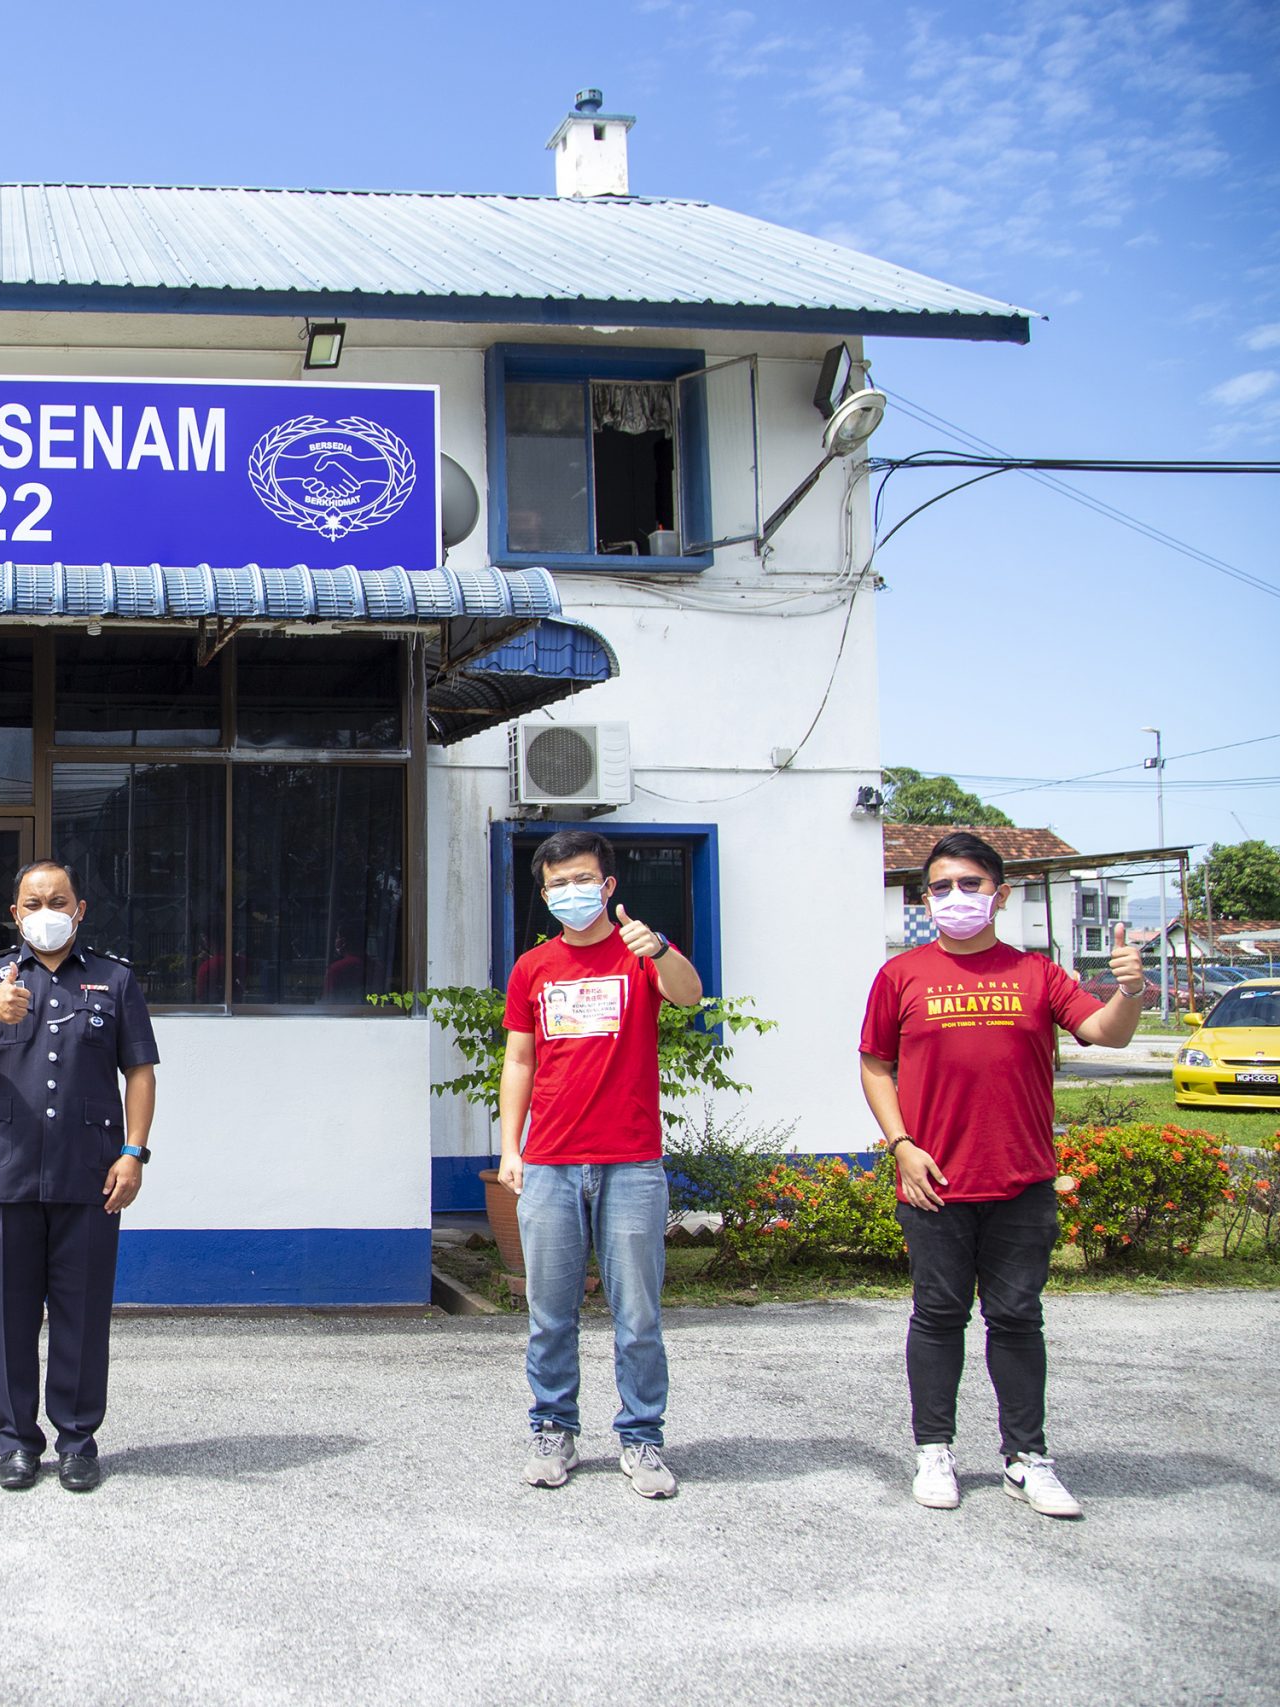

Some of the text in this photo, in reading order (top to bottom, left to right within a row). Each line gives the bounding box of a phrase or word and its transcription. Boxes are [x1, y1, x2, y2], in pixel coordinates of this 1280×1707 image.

[309, 442, 352, 453] BERSEDIA
[304, 495, 361, 507] BERKHIDMAT
[927, 981, 1019, 994] KITA ANAK
[927, 995, 1022, 1015] MALAYSIA
